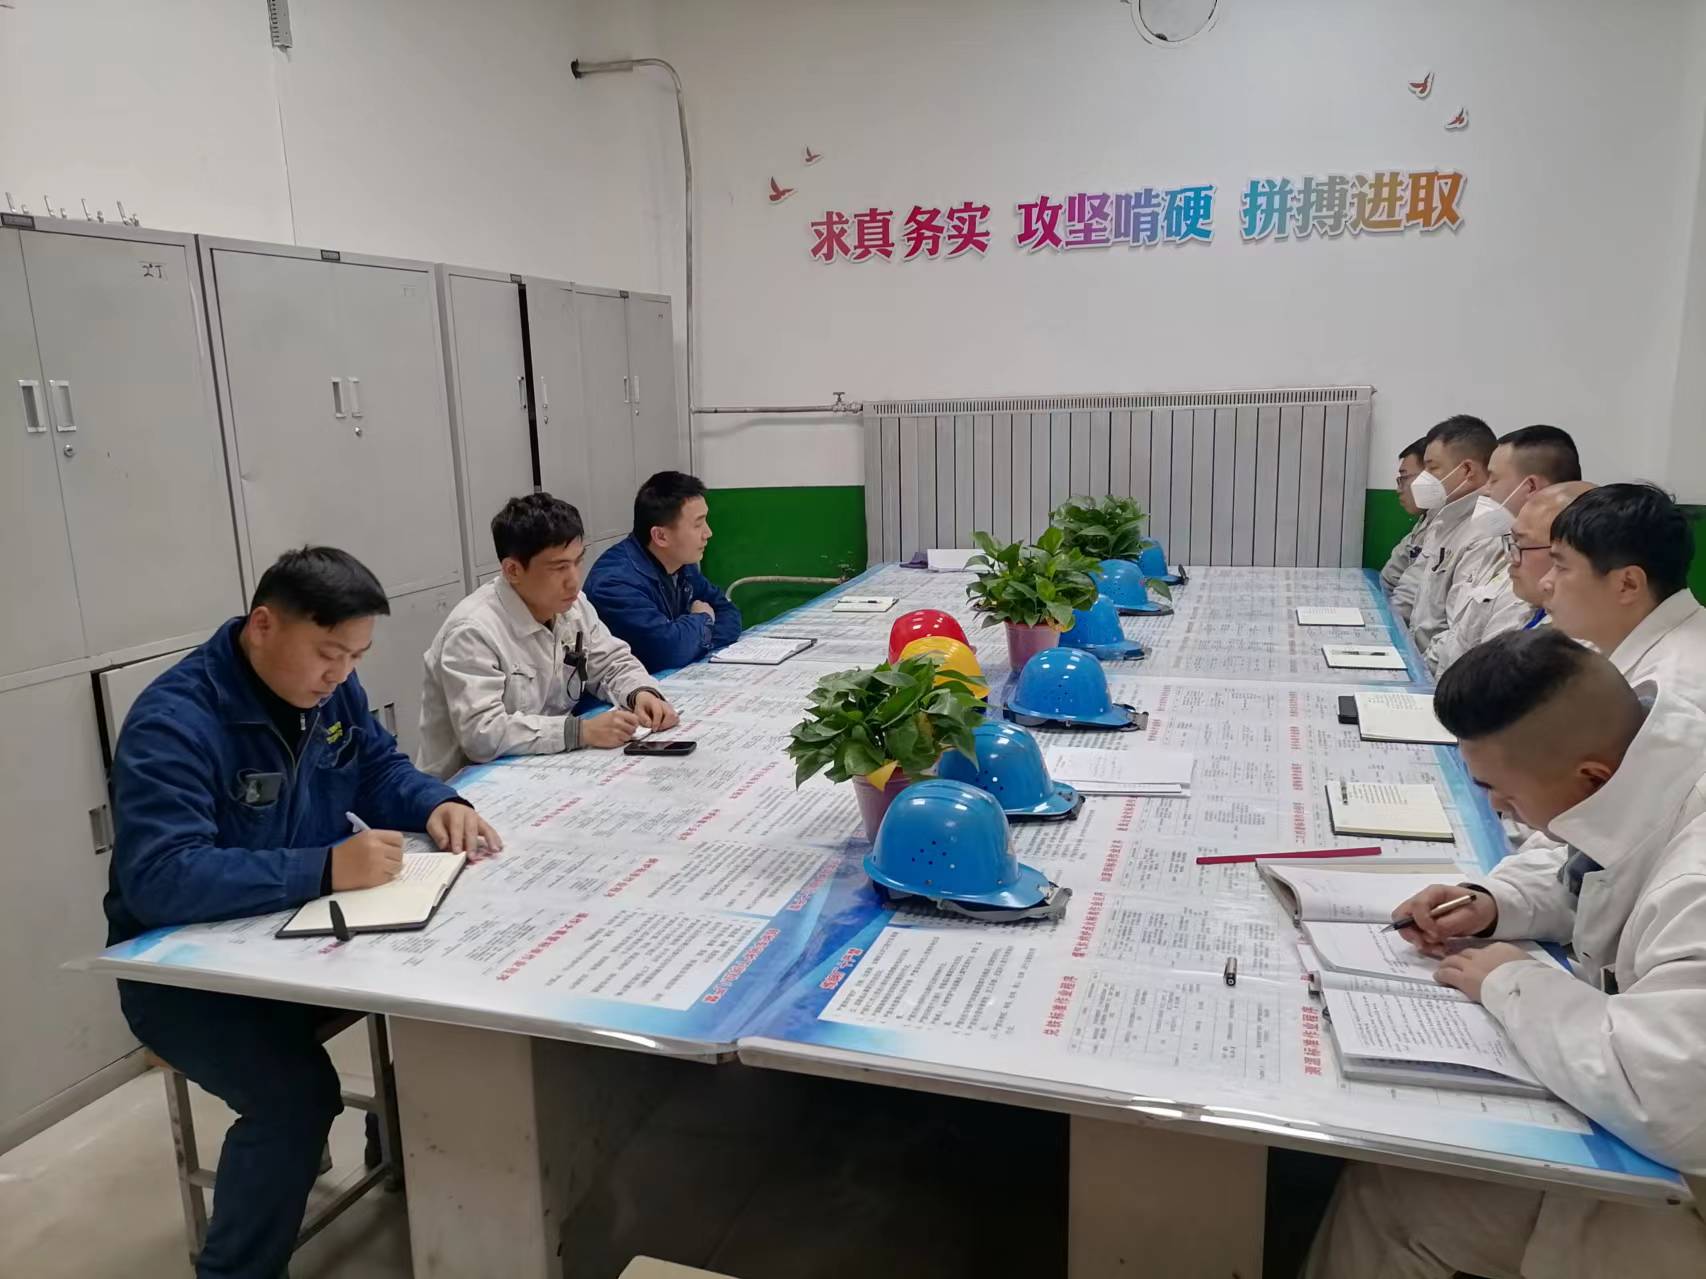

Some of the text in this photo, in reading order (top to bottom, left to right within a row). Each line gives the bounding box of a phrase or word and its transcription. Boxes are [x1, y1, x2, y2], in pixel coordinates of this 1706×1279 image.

[809, 170, 1464, 262] 求真务实 攻坚啃硬 拼搏进取
